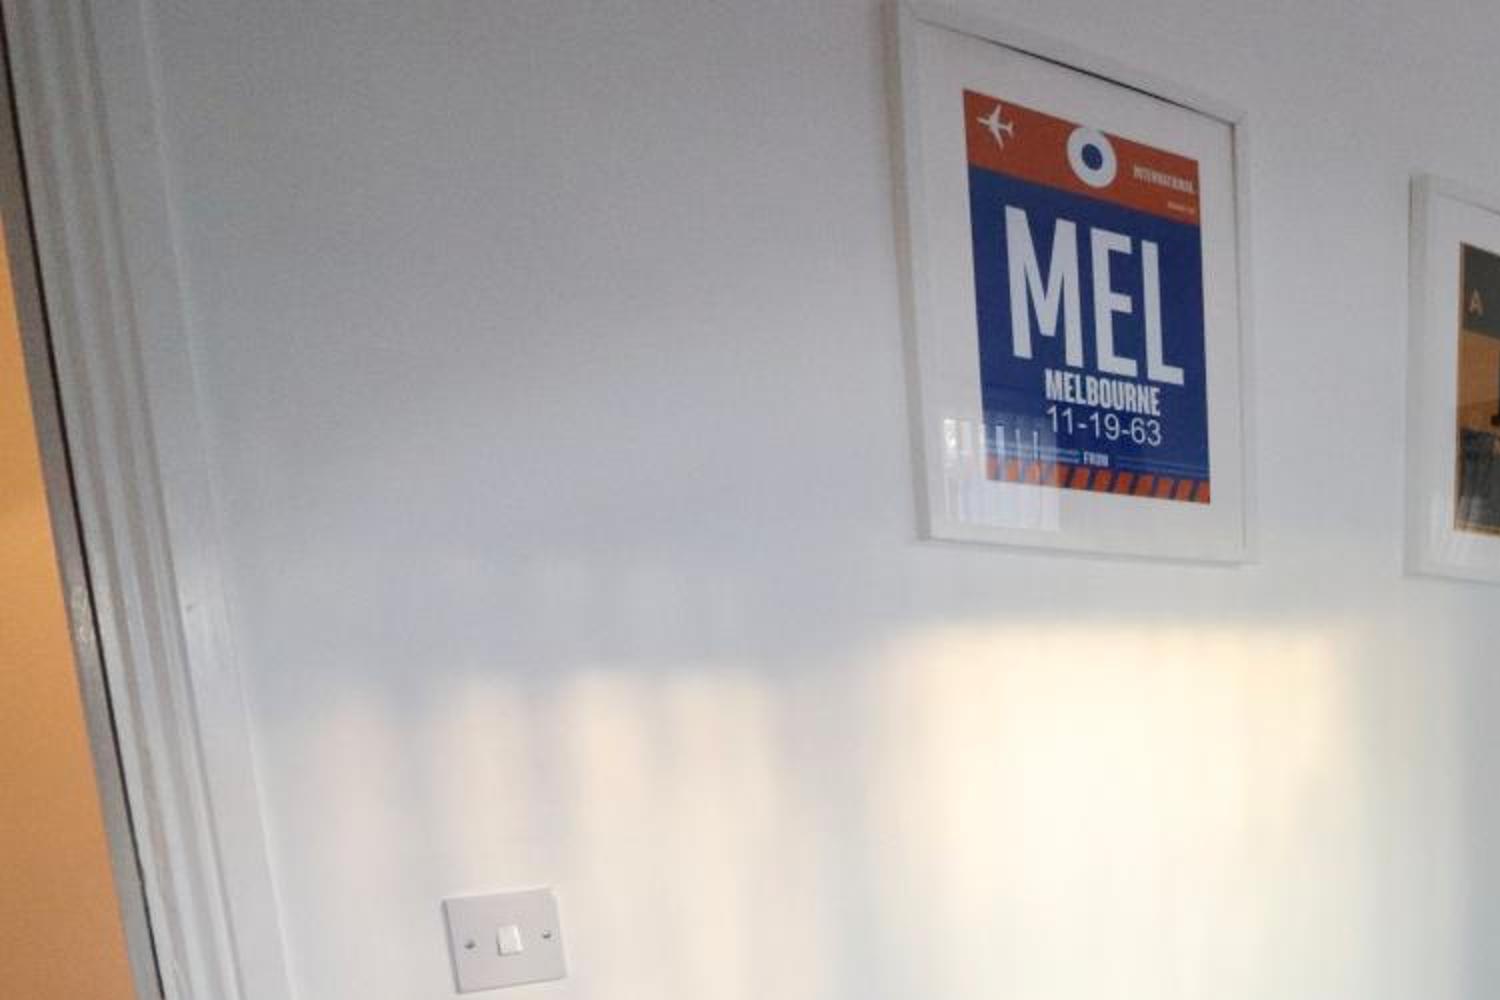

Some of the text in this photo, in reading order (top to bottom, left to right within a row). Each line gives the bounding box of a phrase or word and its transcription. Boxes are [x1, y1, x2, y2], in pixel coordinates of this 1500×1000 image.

[1005, 204, 1184, 385] MEL
[1469, 289, 1484, 316] A
[1045, 368, 1161, 416] MELBOURNE
[1046, 405, 1162, 447] 11-19-63
